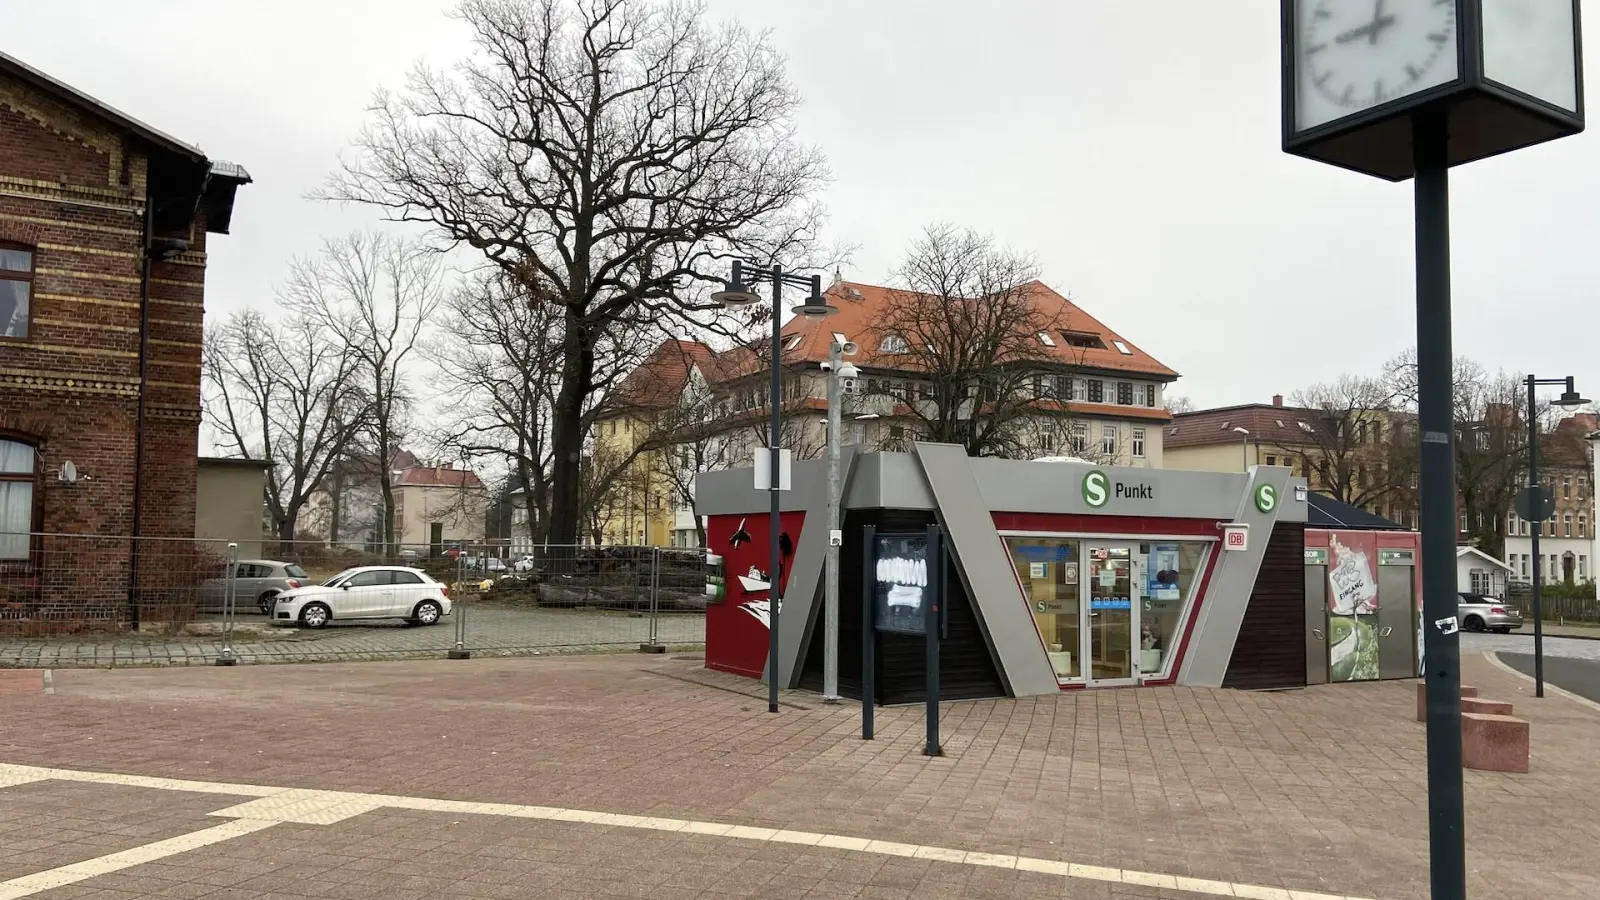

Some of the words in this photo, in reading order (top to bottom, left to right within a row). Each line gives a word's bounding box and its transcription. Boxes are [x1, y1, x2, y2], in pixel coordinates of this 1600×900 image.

[1086, 473, 1106, 506] S
[1115, 482, 1153, 499] Punkt
[1260, 485, 1275, 511] S
[1230, 534, 1243, 544] DB
[1339, 579, 1364, 601] EINGANG
